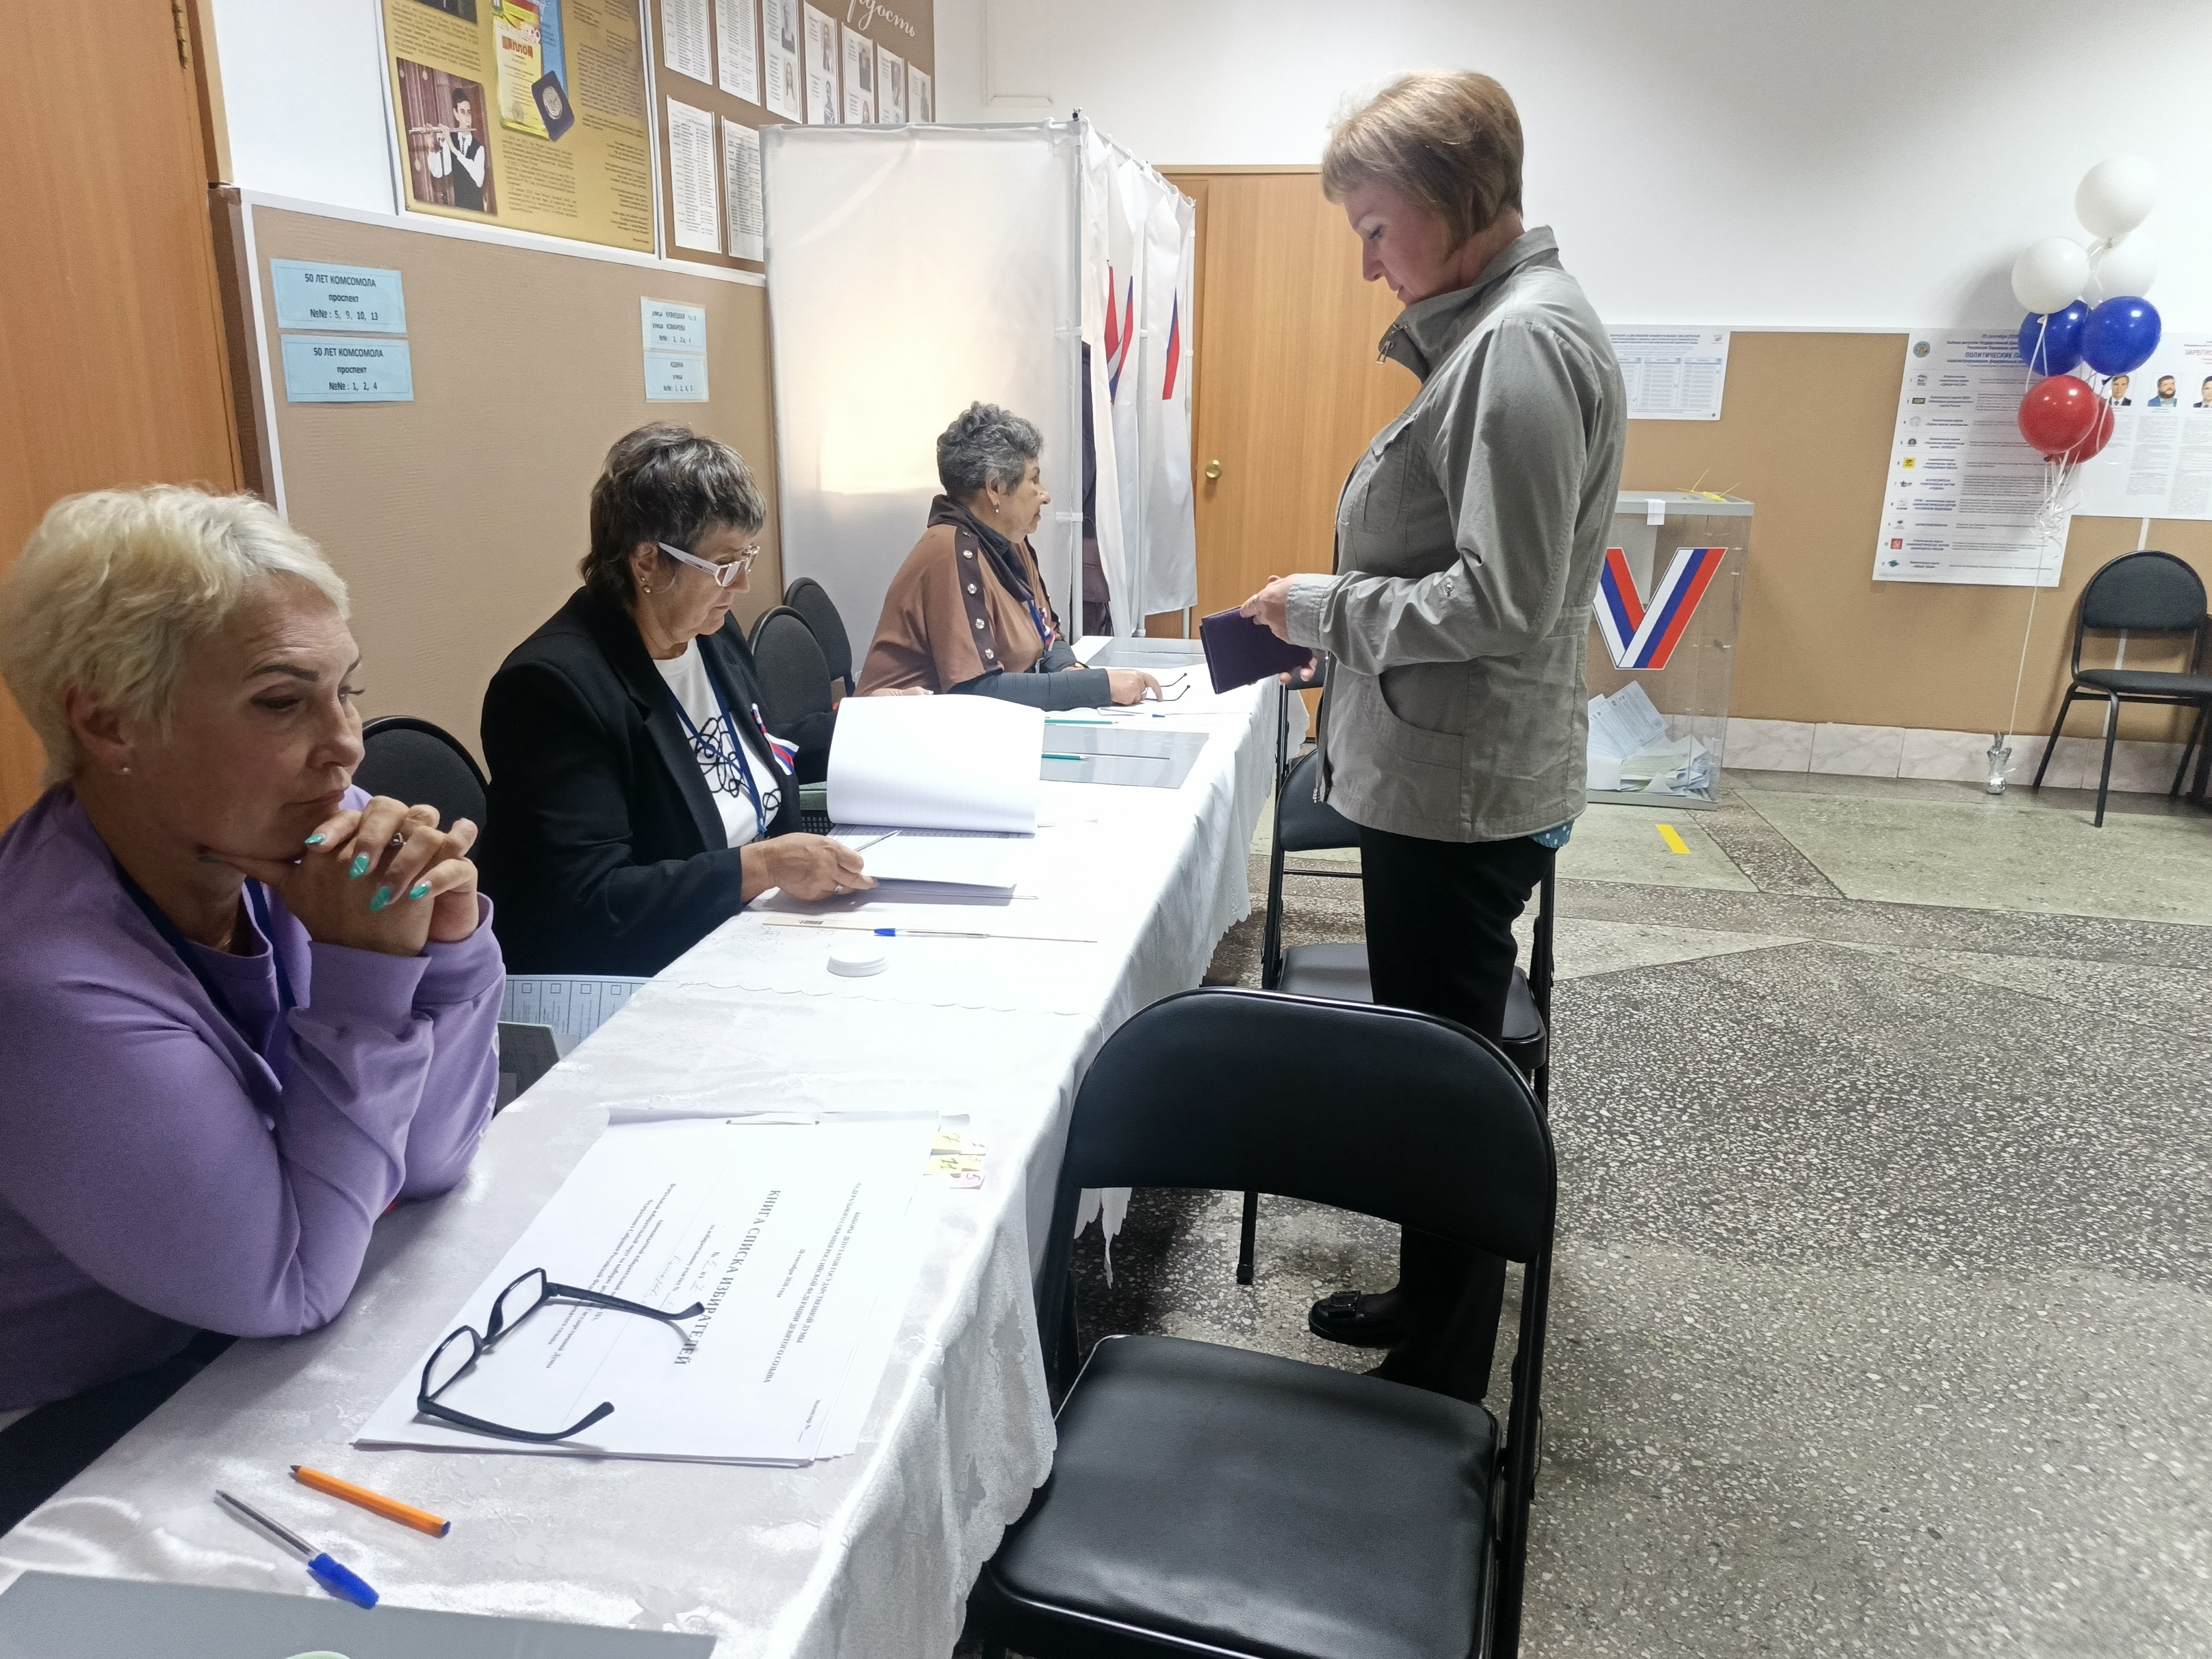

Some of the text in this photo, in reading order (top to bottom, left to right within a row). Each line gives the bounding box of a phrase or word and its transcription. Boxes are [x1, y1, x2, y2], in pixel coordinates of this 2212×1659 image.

[305, 274, 376, 287] 50 ЛЕТ КОМСОМОЛА
[329, 294, 358, 303] проспект
[357, 311, 366, 321] 10,
[314, 348, 383, 357] 50 ЛЕТ КОМСОМОЛА
[630, 1200, 653, 1228] Федерального
[633, 1211, 657, 1244] избирательный
[638, 1220, 663, 1254] одномандатный
[827, 1221, 844, 1248] СОБРАНИЯ
[615, 1230, 633, 1251] Собрания
[624, 1245, 635, 1256] округ
[687, 1231, 711, 1266] избирательному
[597, 1252, 618, 1277] Российской
[605, 1264, 621, 1283] выборах
[614, 1255, 640, 1290] избирательный
[675, 1268, 690, 1285] участку
[788, 1255, 801, 1275] сентября
[810, 1249, 831, 1286] РОССИЙСКОЙ
[674, 1190, 781, 1365] КНИГА СПИСКА ИЗБИРАТЕЛЕЙ
[796, 1212, 861, 1343] ВЫБОРЫ ДЕПУТАТОВ ГОСУДАРСТВЕННОЙ ДУМЫ
[777, 1288, 785, 1297] года
[793, 1287, 813, 1322] ФЕДЕРАЦИИ
[591, 1312, 603, 1320] 103,
[548, 1328, 563, 1344] созыва
[558, 1308, 592, 1351] Государственной
[777, 1323, 796, 1355] ДЕВЯТОГО
[546, 1352, 561, 1368] Думы
[764, 1356, 781, 1382] СОЗЫВА
